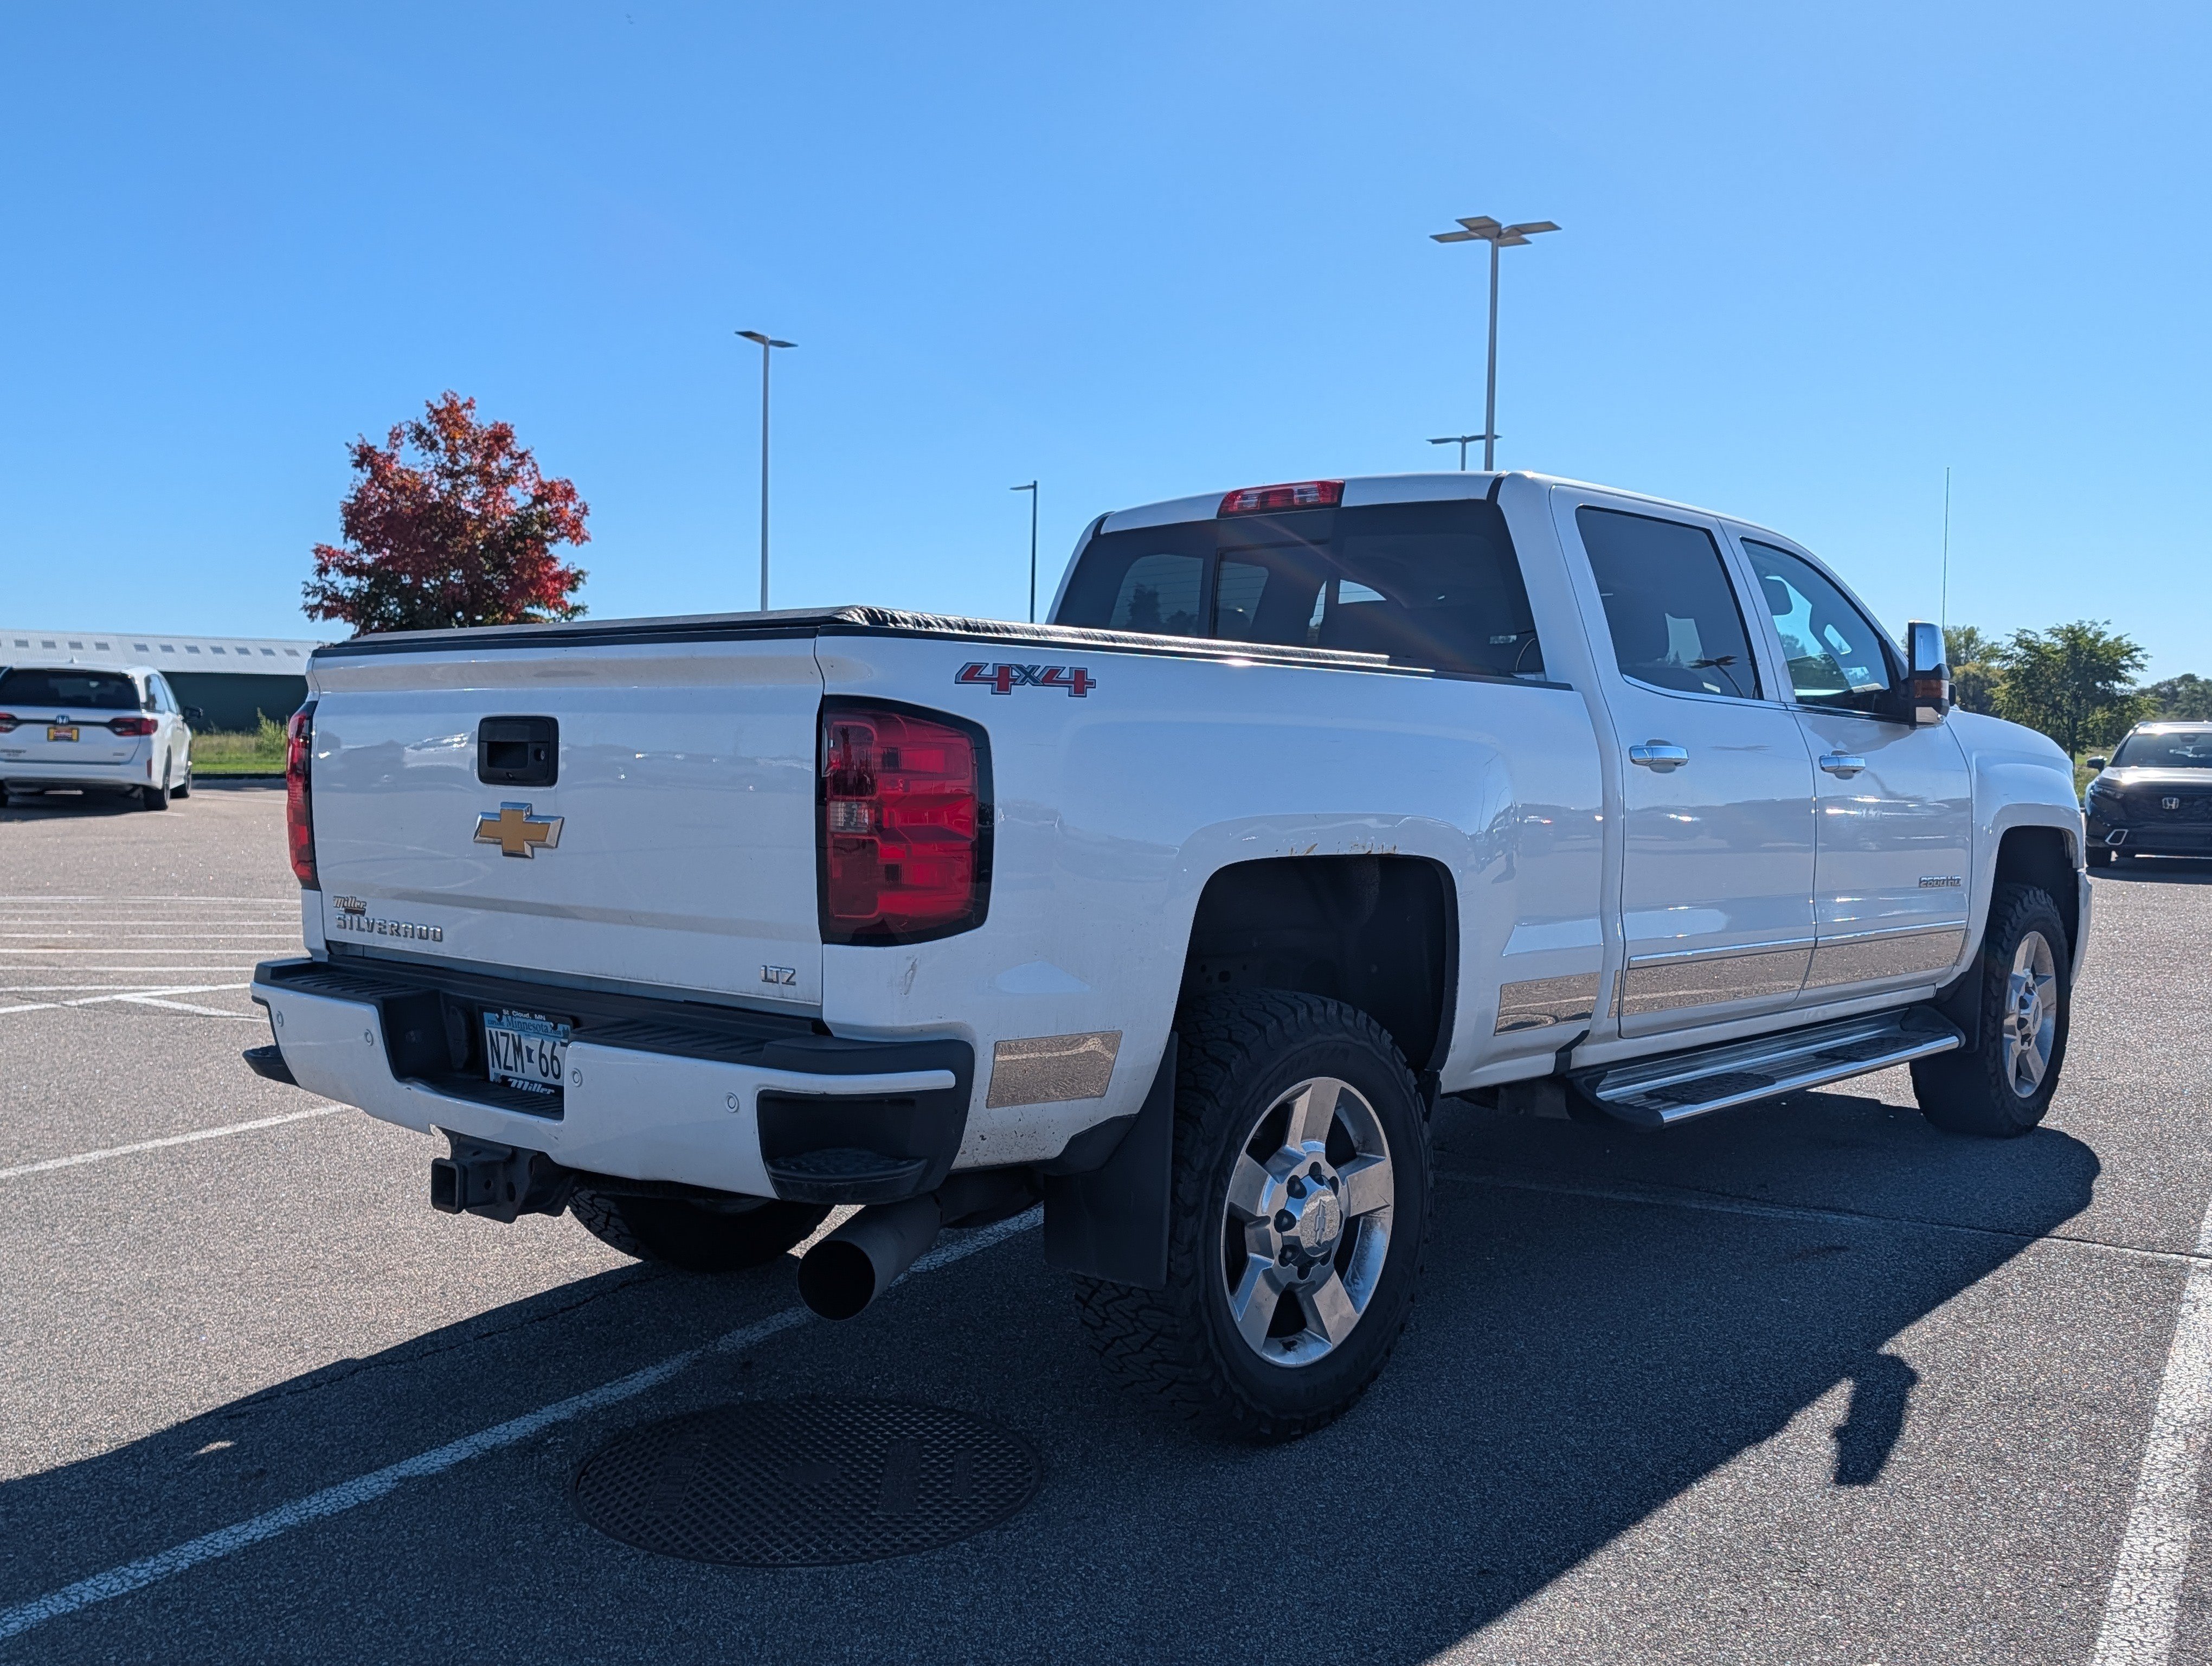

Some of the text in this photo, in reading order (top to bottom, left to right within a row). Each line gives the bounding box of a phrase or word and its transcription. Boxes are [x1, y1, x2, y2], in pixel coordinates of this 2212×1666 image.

[333, 895, 367, 909] Miller
[336, 913, 443, 943] SILVERADO
[760, 965, 796, 986] LTZ
[489, 1030, 525, 1074] NZM
[508, 1078, 555, 1095] Miller
